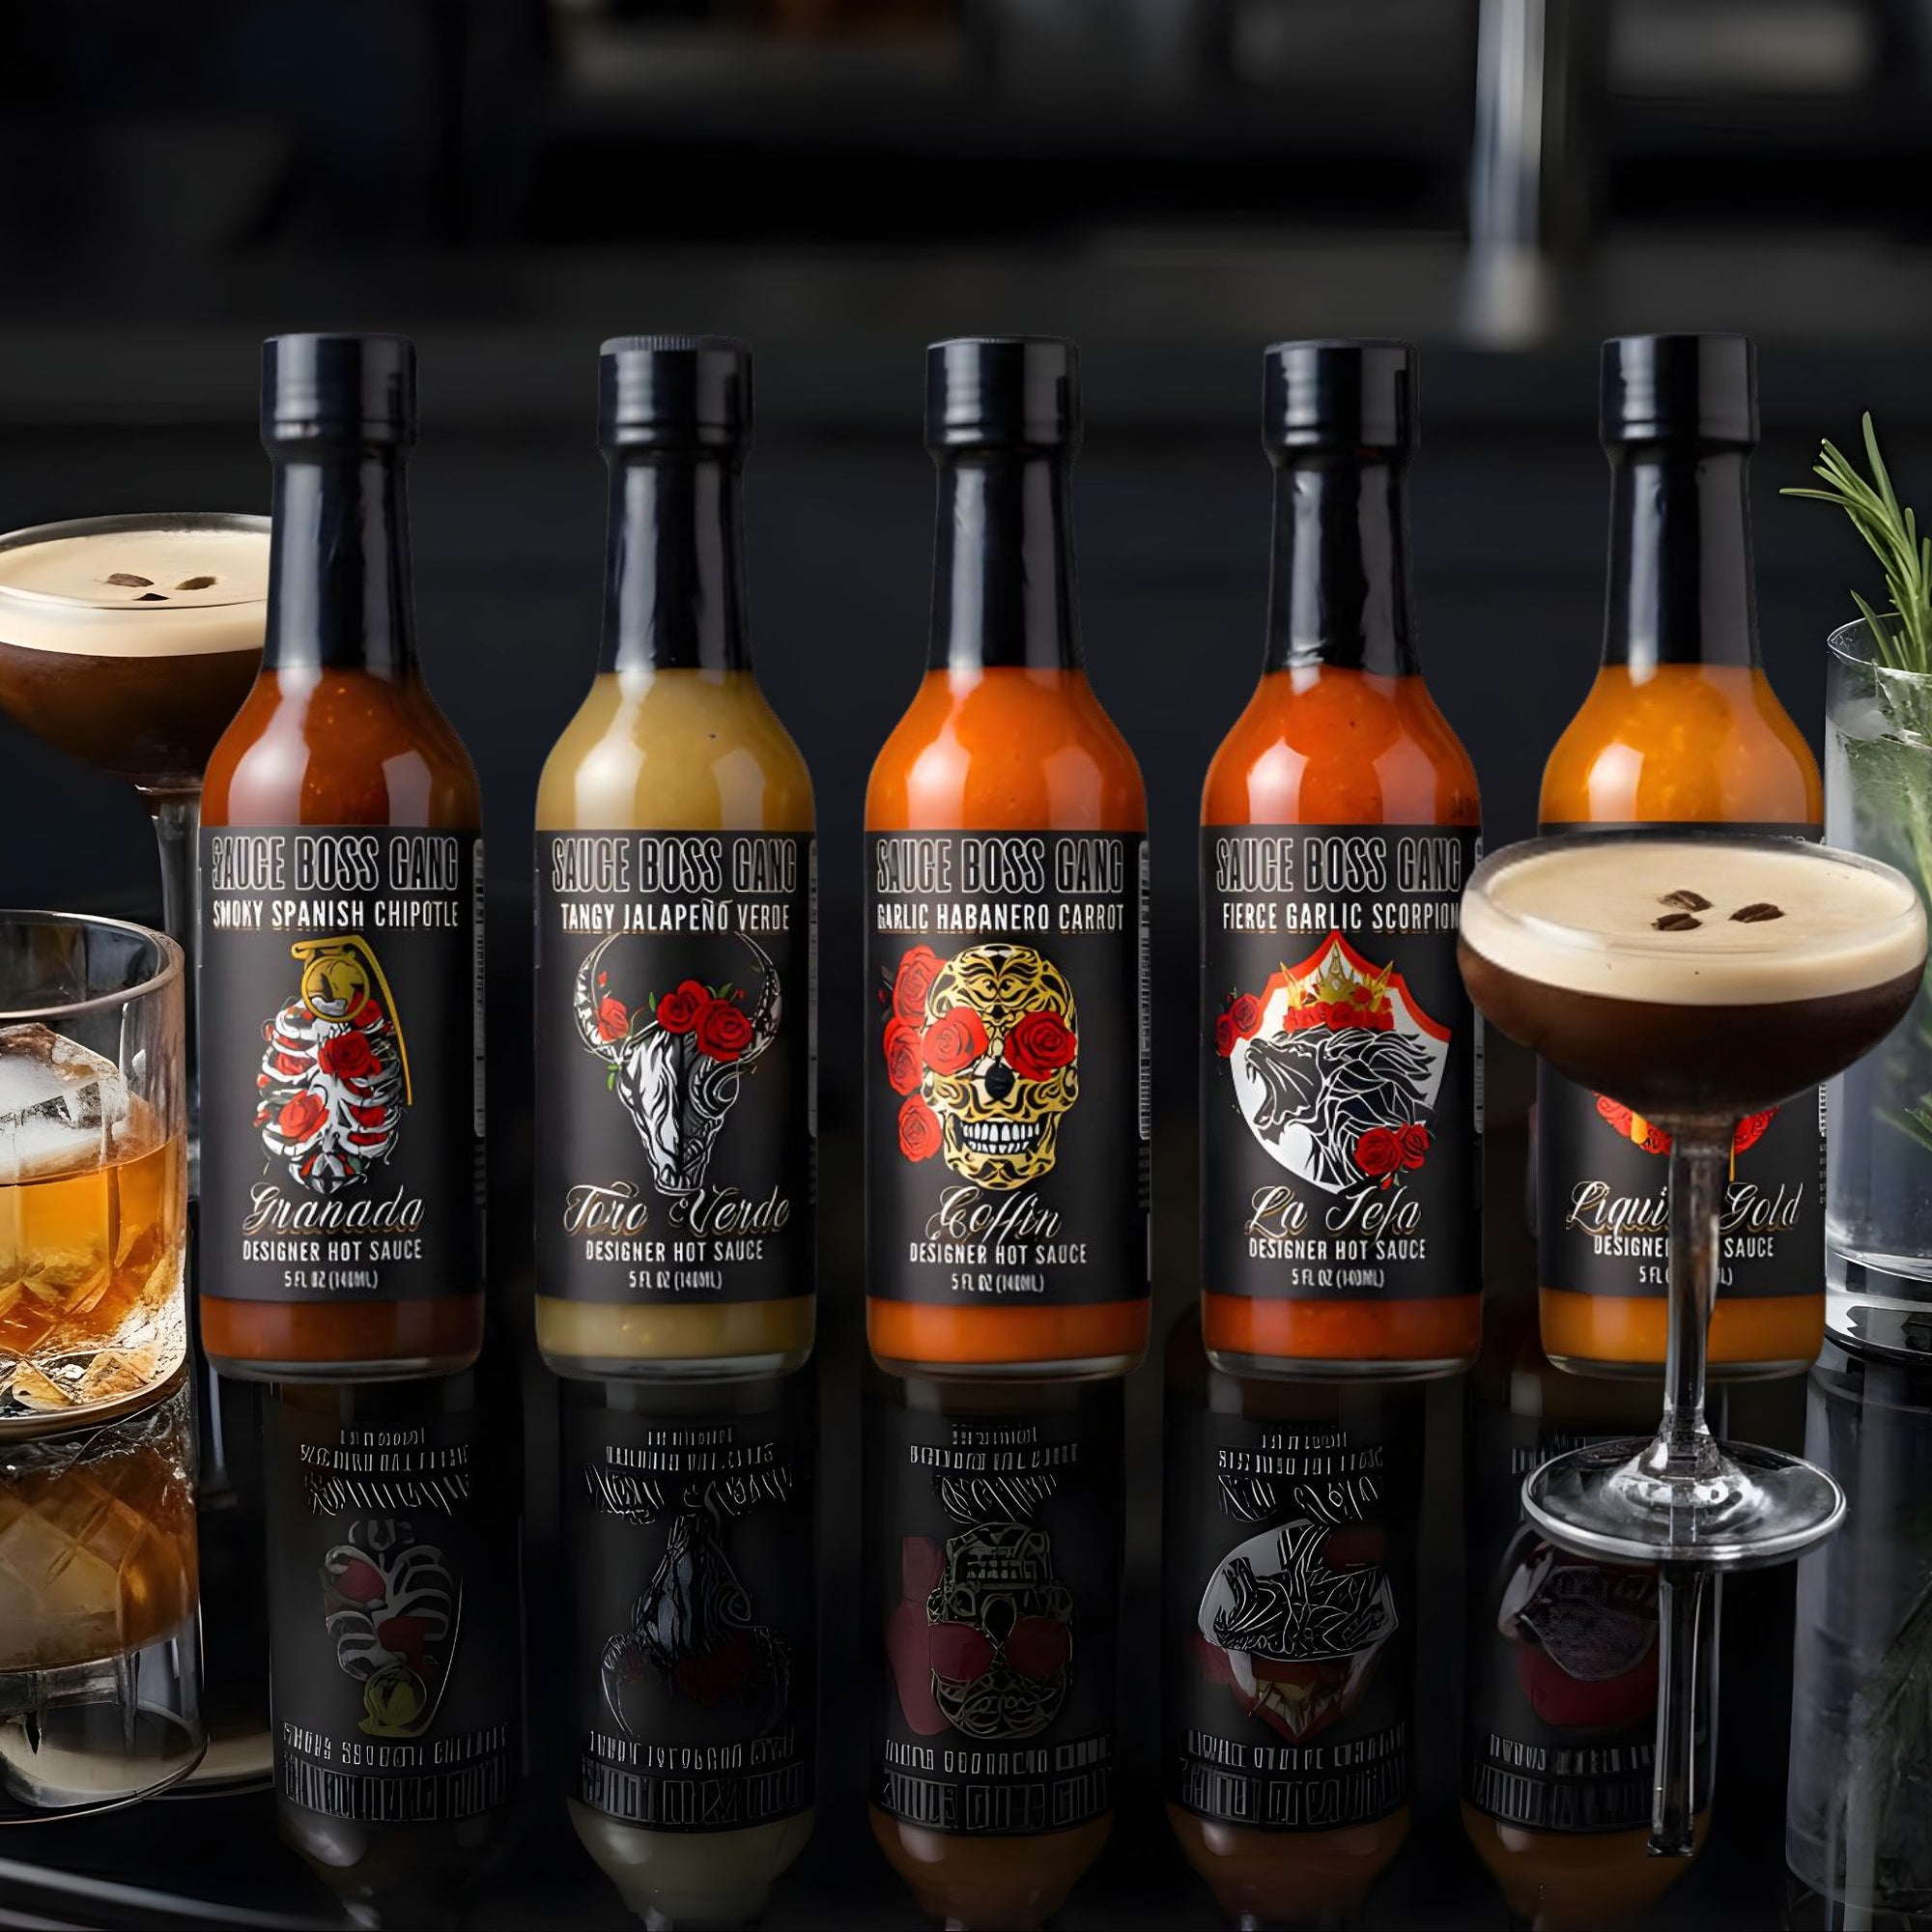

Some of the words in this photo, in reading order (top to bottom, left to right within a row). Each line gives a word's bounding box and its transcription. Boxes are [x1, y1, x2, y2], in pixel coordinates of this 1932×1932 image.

[213, 836, 285, 891] SAUCE
[295, 836, 379, 891] BOSS
[389, 836, 459, 891] GANG
[553, 838, 630, 893] SAUCE
[639, 838, 722, 893] BOSS
[733, 838, 797, 893] GANG
[876, 838, 952, 893] SAUCE
[961, 838, 1044, 893] BOSS
[1056, 838, 1123, 893] GANG
[1216, 837, 1293, 892] SAUCE
[1304, 837, 1387, 892] BOSS
[1398, 837, 1461, 892] GANG
[213, 899, 263, 927] SMOKY
[271, 899, 364, 927] SPANISH
[375, 900, 459, 927] CHIPOTLE
[560, 903, 614, 930] TANGY
[623, 898, 731, 931] JALAPEÑO
[737, 904, 789, 930] VERDE
[877, 903, 928, 930] GARLIC
[936, 903, 1049, 930] HABANERO
[1059, 903, 1124, 930] CARROT
[1223, 902, 1277, 929] FIERCE
[1287, 902, 1362, 929] GARLIC
[1372, 902, 1459, 929] SCORPION
[242, 1181, 425, 1233] Granada
[563, 1180, 648, 1234] Toro
[668, 1184, 790, 1236] Verde
[925, 1185, 1063, 1245] Coffin
[1246, 1185, 1307, 1239] La
[1325, 1185, 1421, 1246] Jefa
[1566, 1180, 1669, 1237] Liqui
[1720, 1181, 1804, 1232] Gold
[242, 1240, 321, 1261] DESIGNER
[328, 1241, 362, 1261] HOT
[370, 1239, 422, 1261] SAUCE
[585, 1240, 666, 1262] DESIGNER
[674, 1241, 706, 1262] HOT
[713, 1239, 763, 1261] SAUCE
[910, 1242, 986, 1264] DESIGNER
[996, 1244, 1028, 1264] HOT
[1036, 1243, 1087, 1264] SAUCE
[1249, 1237, 1327, 1260] DESIGNER
[1335, 1240, 1368, 1260] HOT
[1376, 1238, 1426, 1260] SAUCE
[1724, 1236, 1774, 1258] SAUCE
[284, 1270, 292, 1288] 5
[629, 1270, 637, 1288] 5
[952, 1273, 959, 1291] 5
[1292, 1267, 1299, 1286] 5
[1639, 1265, 1647, 1283] 5
[1649, 1266, 1662, 1284] FL
